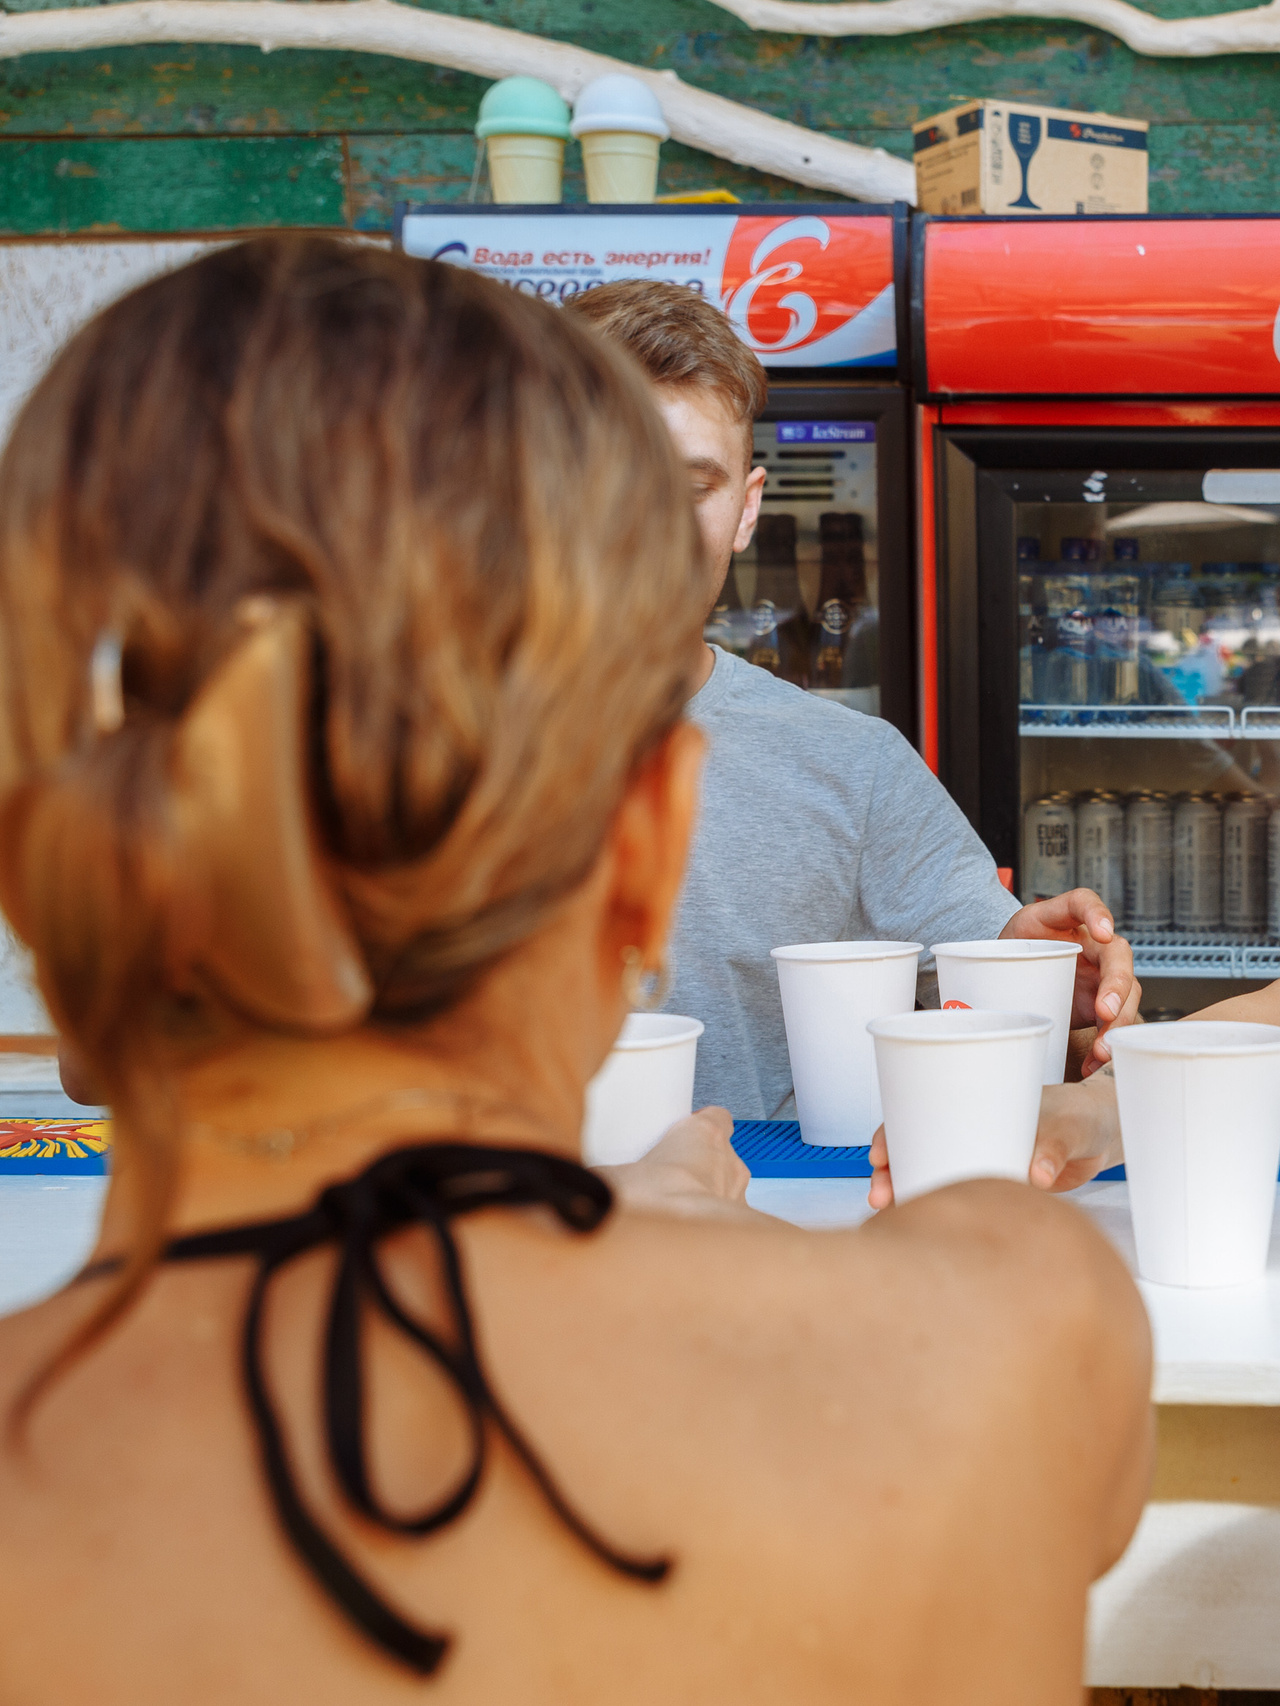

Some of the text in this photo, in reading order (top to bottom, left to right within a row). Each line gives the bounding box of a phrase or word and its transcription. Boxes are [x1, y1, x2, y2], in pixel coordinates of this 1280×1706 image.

[473, 247, 533, 266] Вода
[542, 251, 596, 266] есть
[604, 247, 712, 269] энергия!
